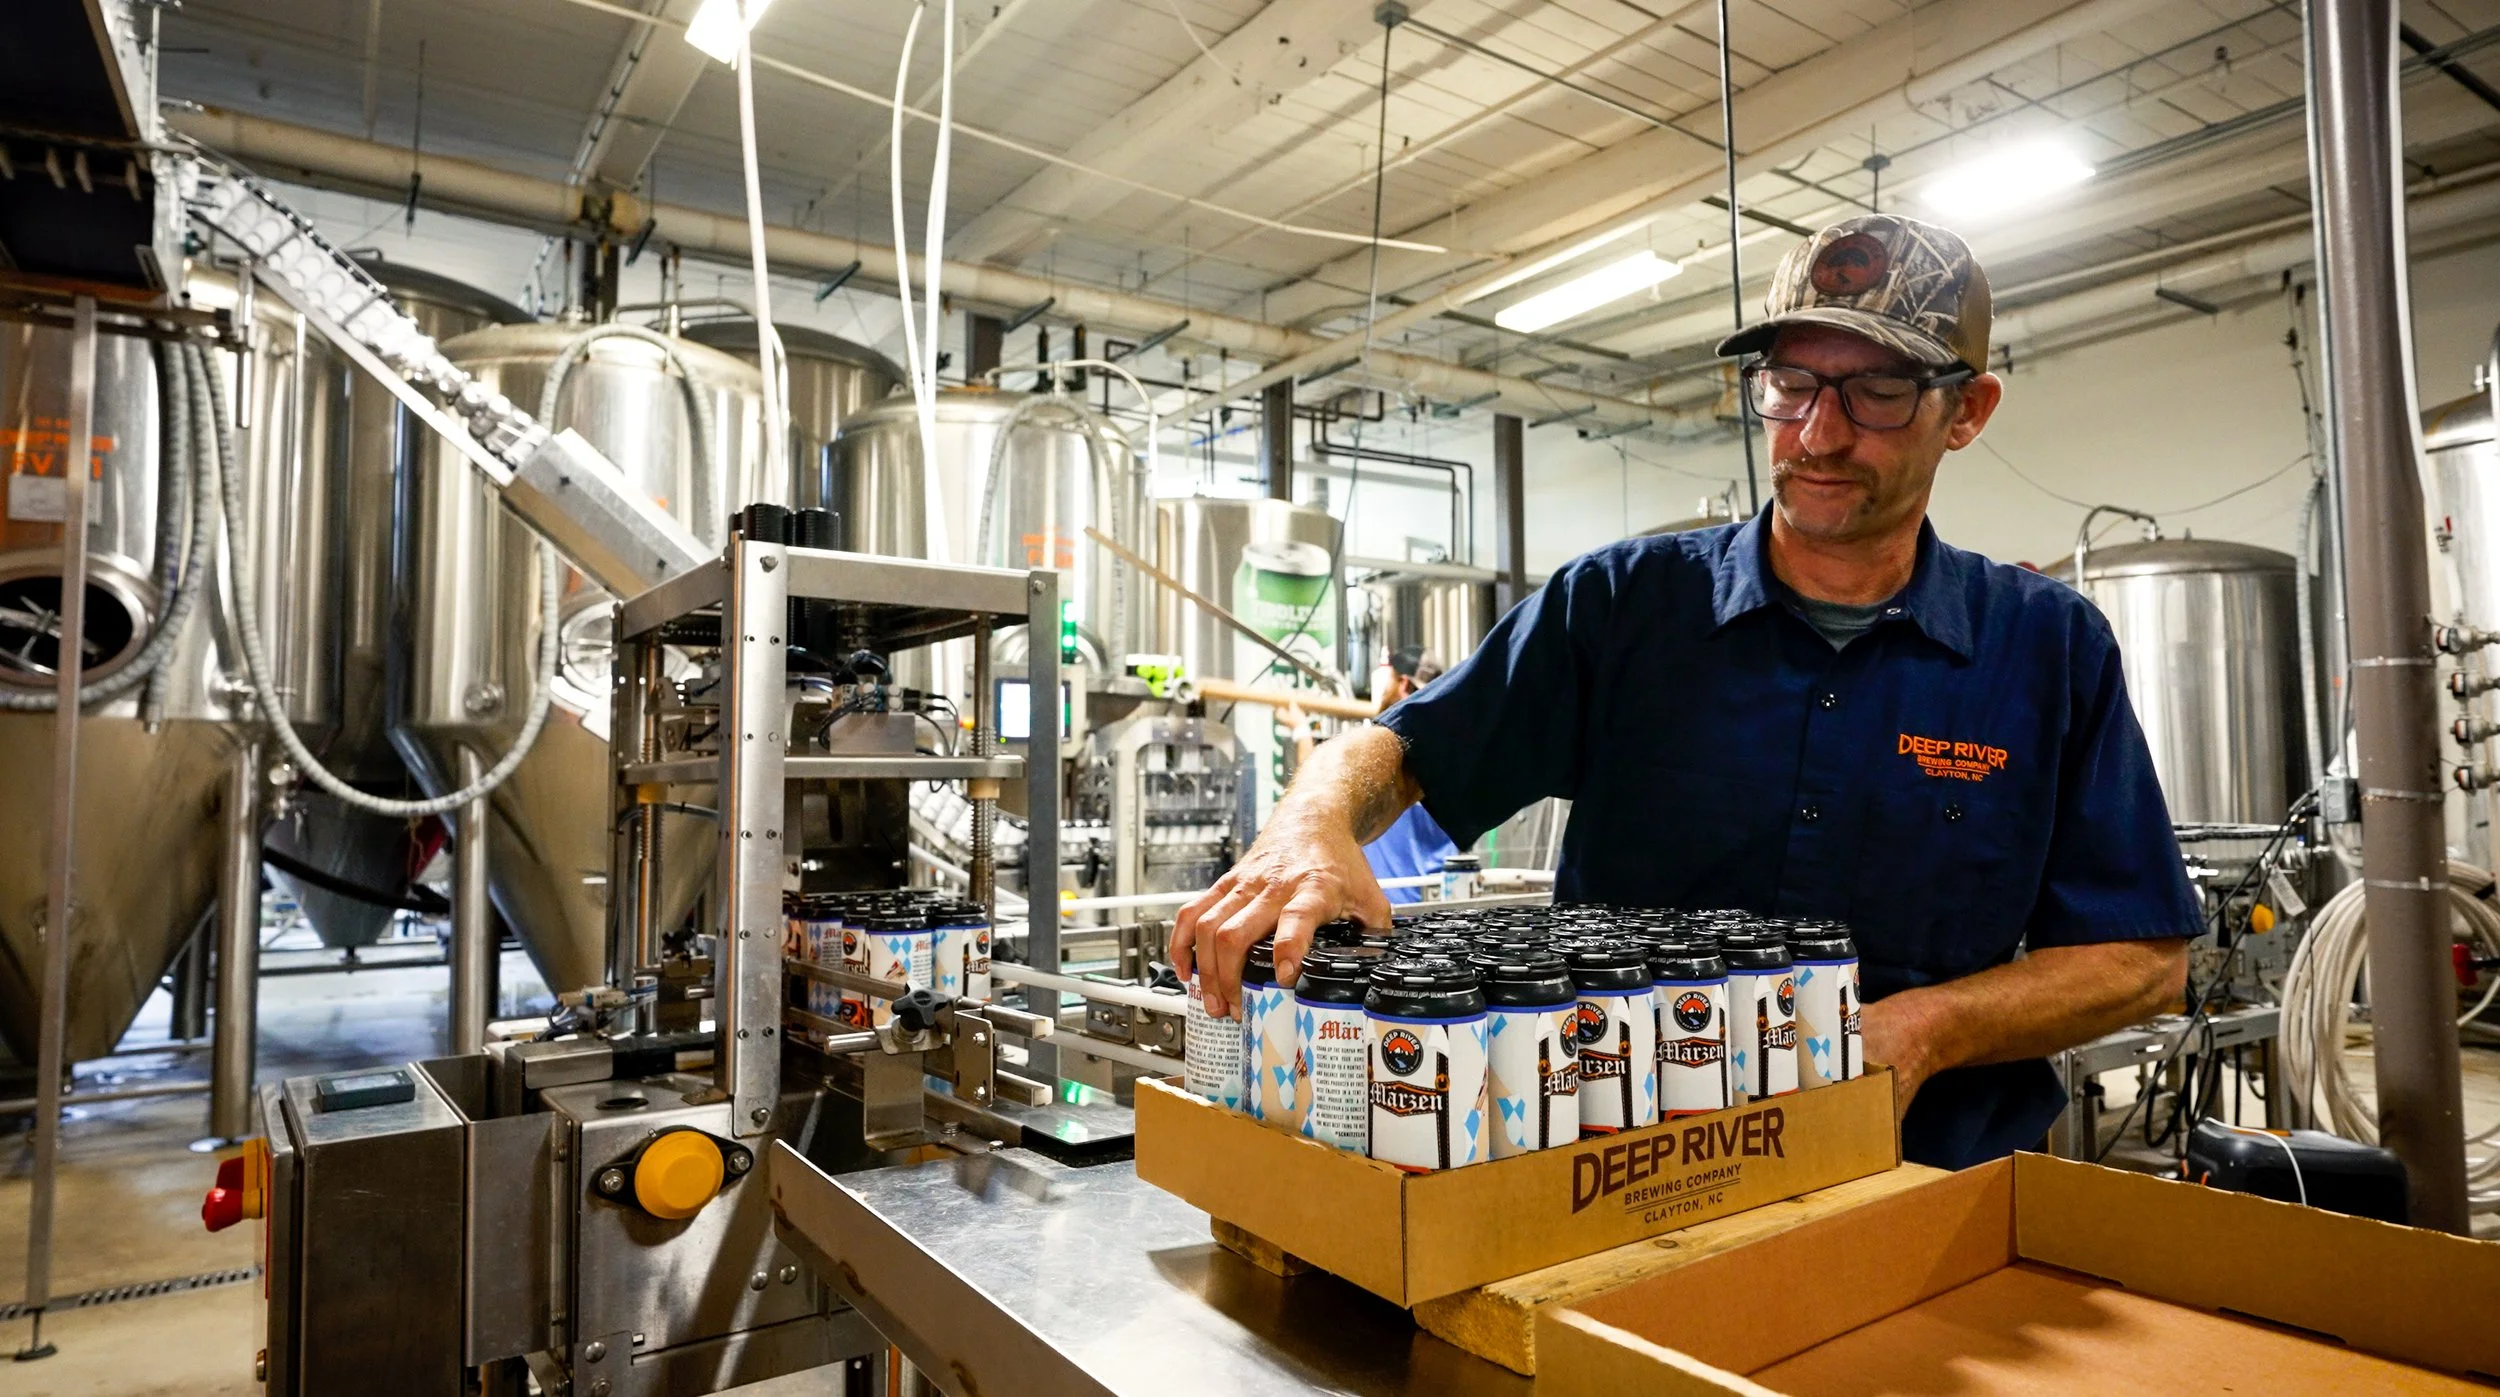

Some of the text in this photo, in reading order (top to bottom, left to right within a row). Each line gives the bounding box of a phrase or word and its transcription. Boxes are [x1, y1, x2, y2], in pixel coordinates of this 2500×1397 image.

[1898, 733, 2008, 769] DEEP RIVER
[1917, 755, 1990, 771] BREWING COMPANY
[1925, 768, 1984, 782] CLAYTON, NC
[1585, 1003, 1605, 1020] RIVER
[1676, 993, 1710, 1009] DEEP RIVER
[1318, 1020, 1362, 1040] Mär
[1763, 1027, 1796, 1048] Mär
[1383, 1031, 1420, 1051] DEEP RIVER
[1655, 1041, 1724, 1062] Märzen
[1580, 1059, 1626, 1075] rzen
[1544, 1069, 1578, 1097] Mär
[1370, 1082, 1443, 1111] Märzen
[1572, 1107, 1785, 1215] DEEP RIVER
[1624, 1163, 1742, 1206] BREWING COMPANY
[1644, 1192, 1724, 1224] CLAYTON, NC
